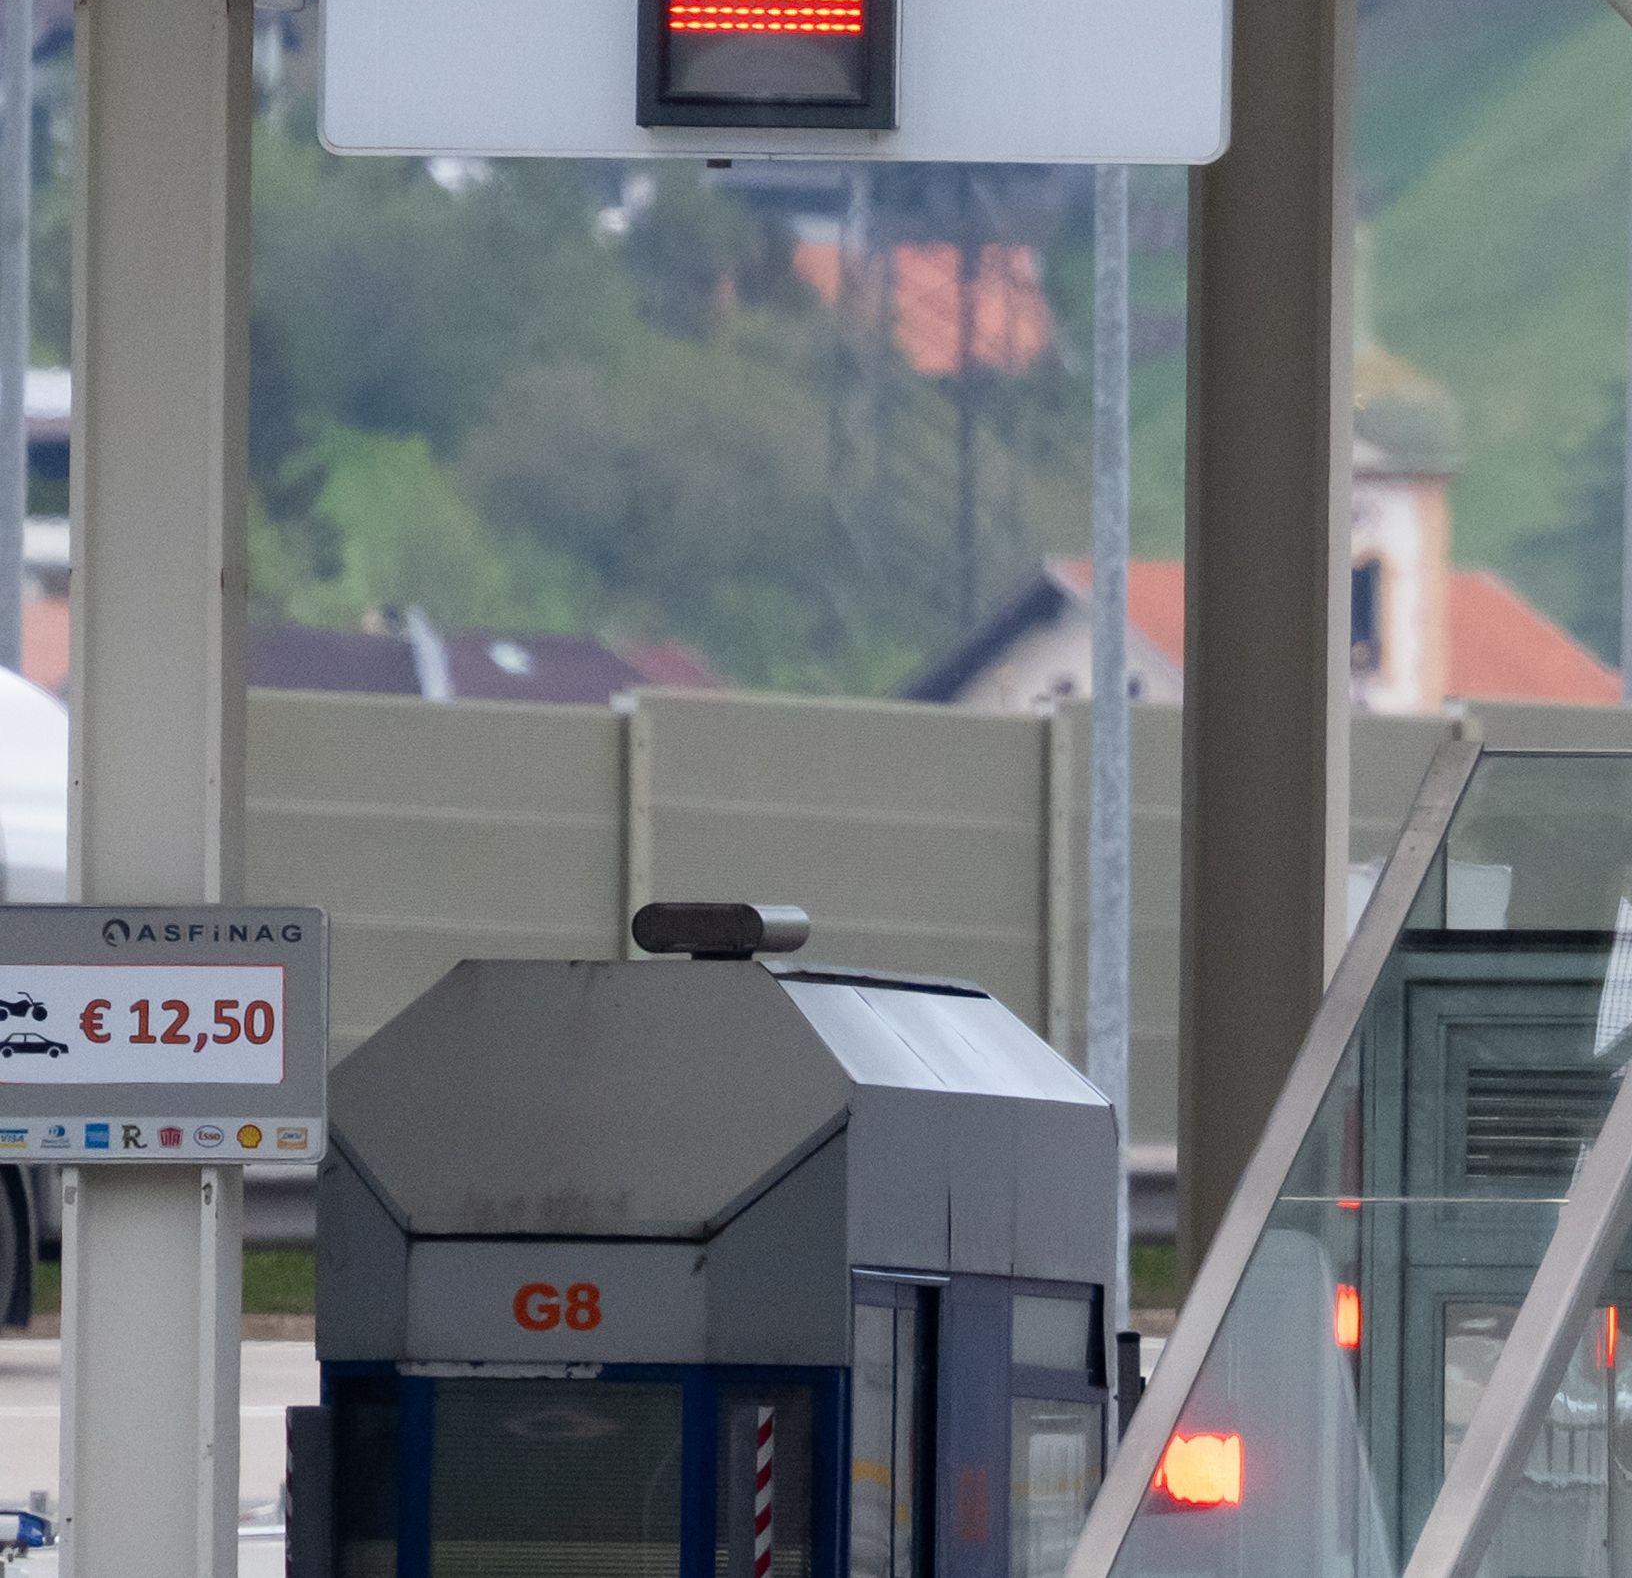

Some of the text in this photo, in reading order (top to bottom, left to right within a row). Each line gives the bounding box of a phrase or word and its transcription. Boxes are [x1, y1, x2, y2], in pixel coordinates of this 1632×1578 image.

[79, 998, 275, 1054] € 12,50
[513, 1283, 603, 1331] G8
